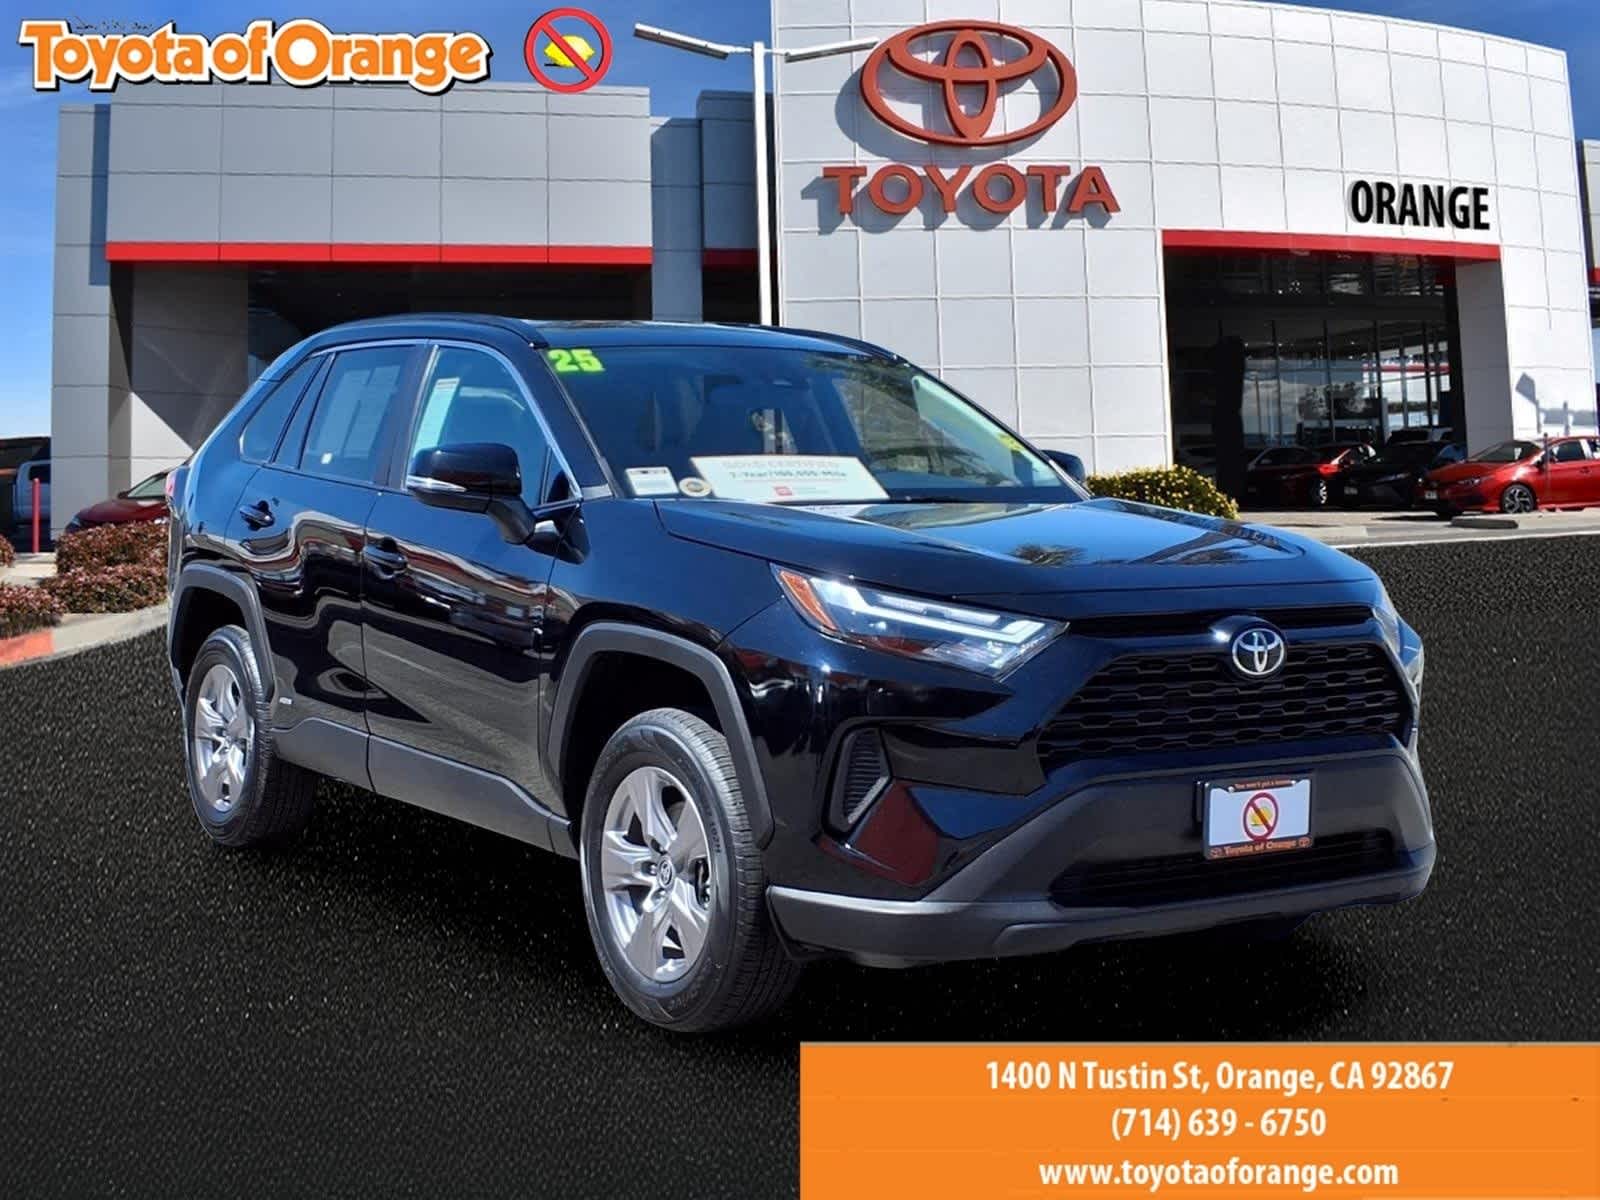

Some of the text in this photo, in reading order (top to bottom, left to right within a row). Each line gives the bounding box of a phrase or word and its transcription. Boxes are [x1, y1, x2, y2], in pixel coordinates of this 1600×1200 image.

[822, 163, 1121, 215] TOYOTA
[1350, 180, 1490, 230] ORANGE
[548, 349, 606, 372] 25
[1223, 844, 1253, 857] Toyota
[1255, 843, 1265, 852] of
